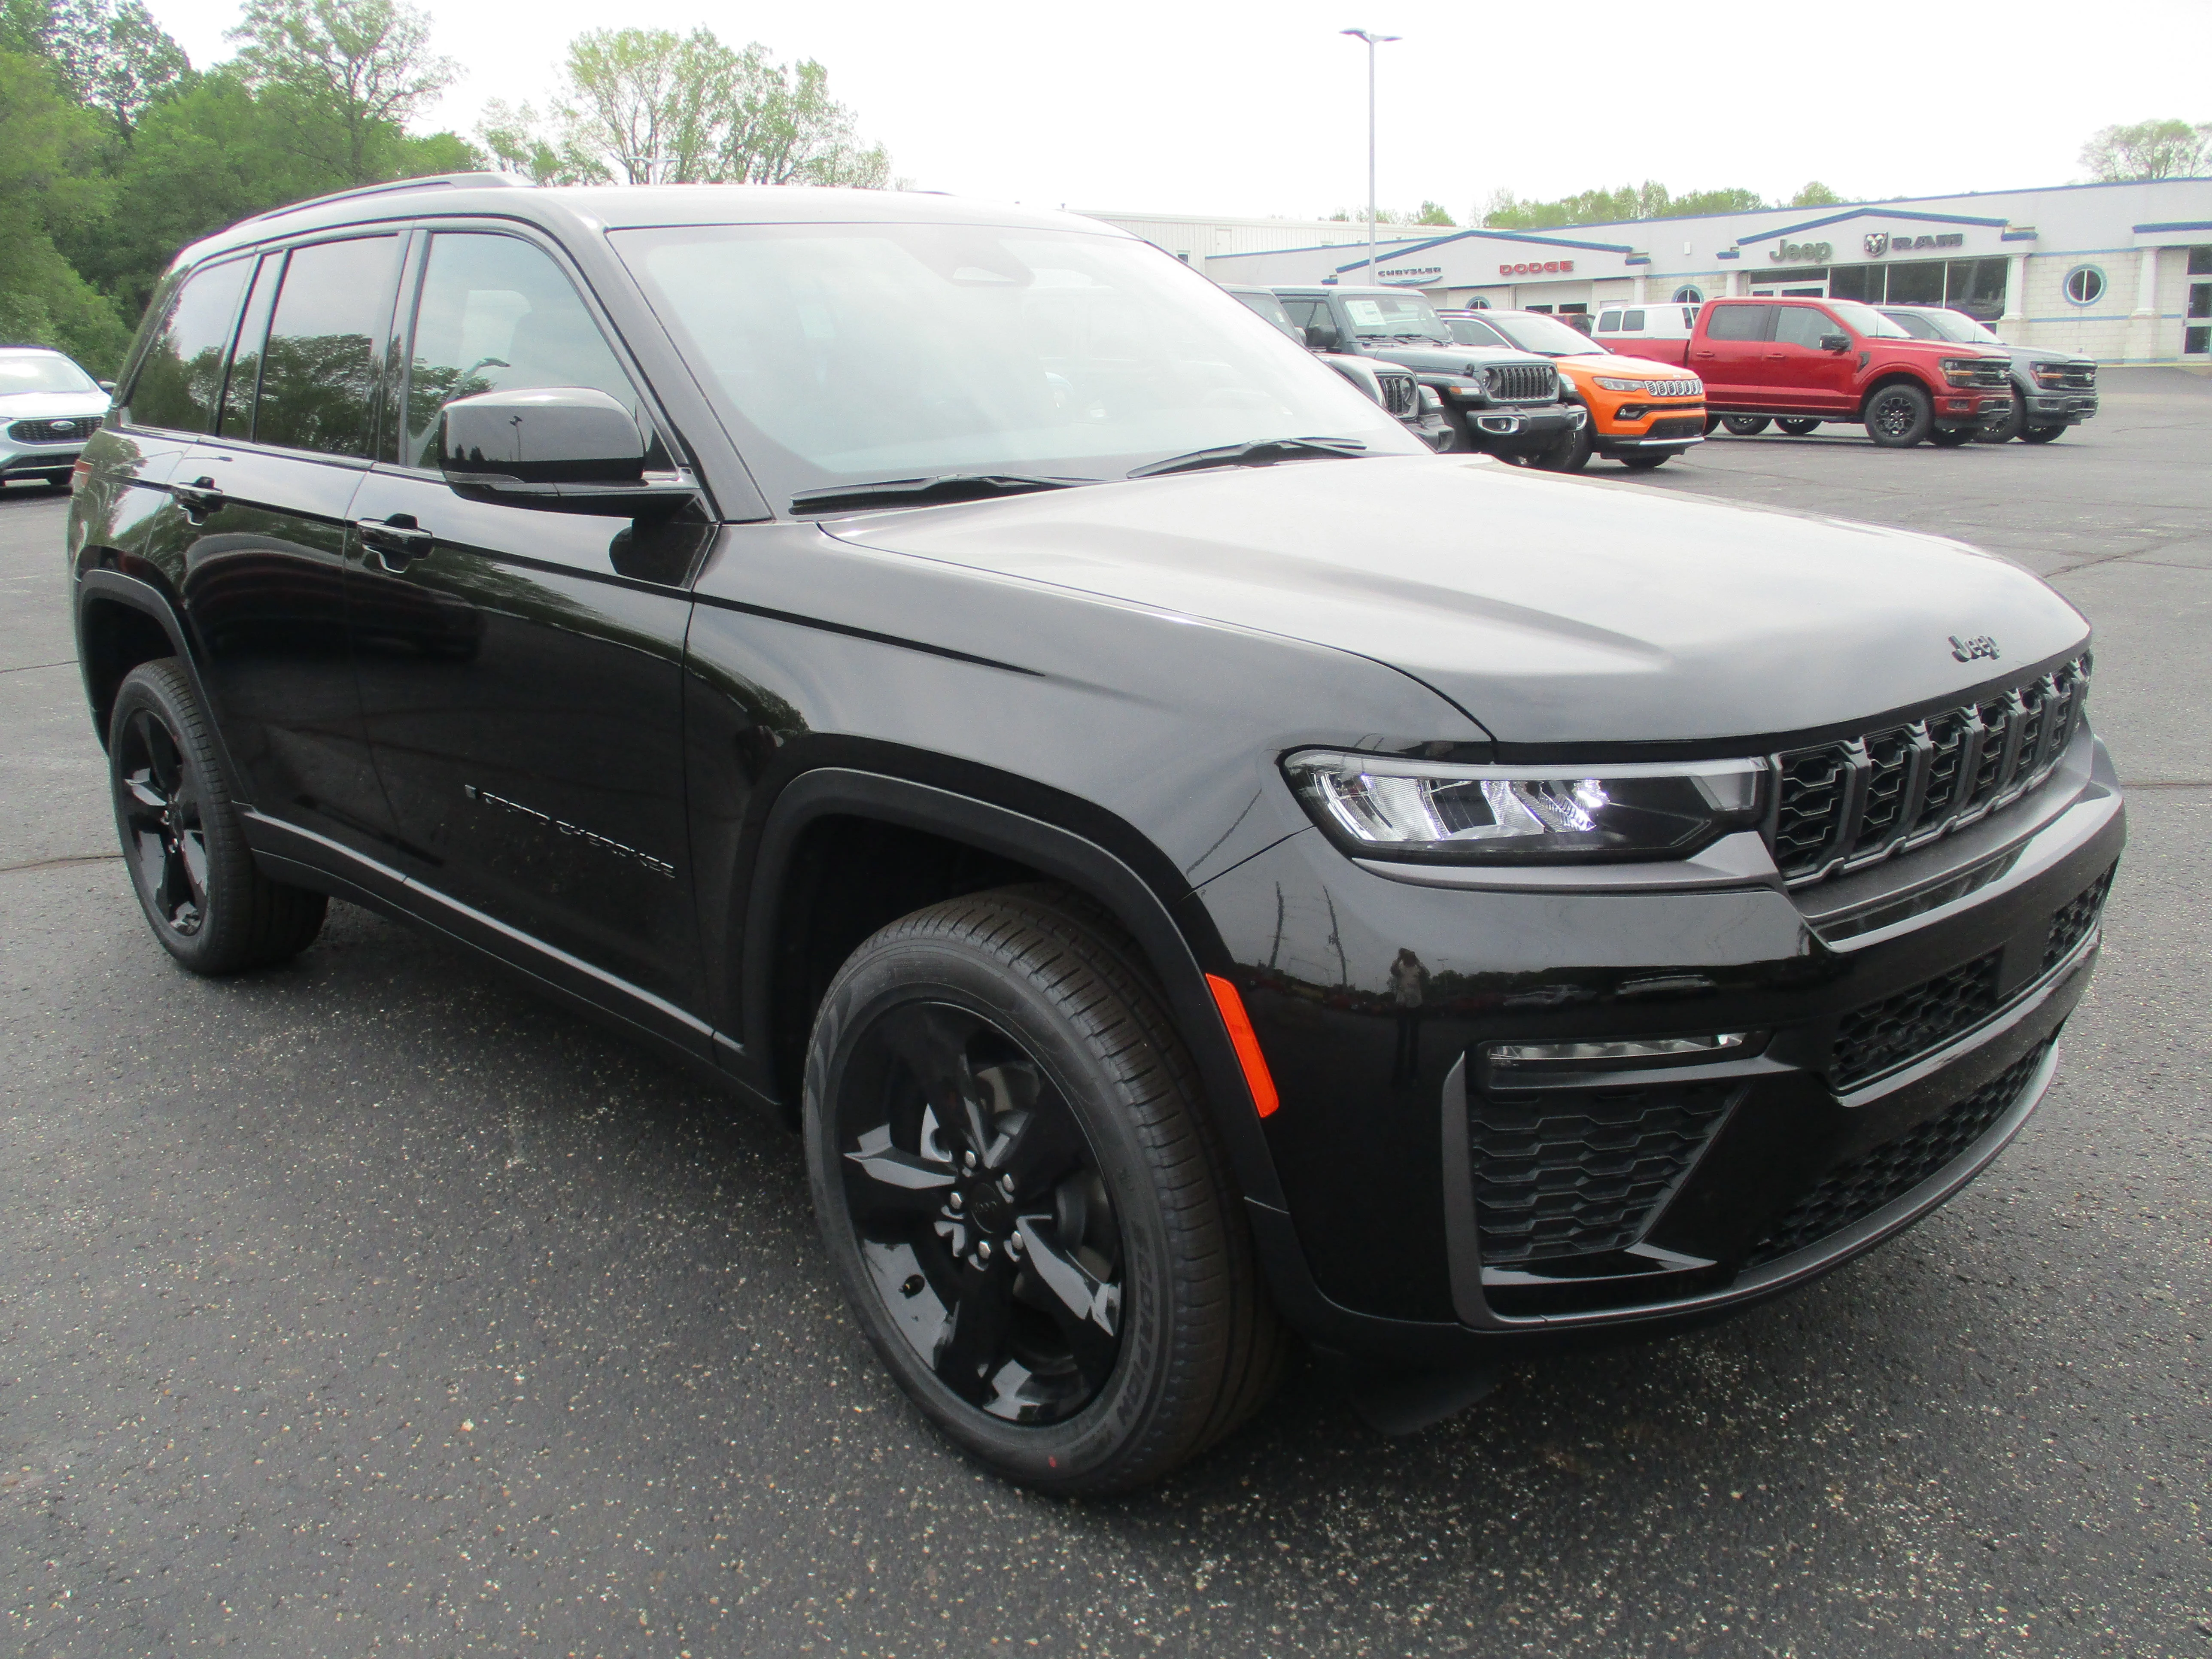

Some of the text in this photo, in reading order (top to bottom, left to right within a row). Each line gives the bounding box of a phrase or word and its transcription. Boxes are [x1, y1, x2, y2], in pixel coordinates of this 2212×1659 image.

[1892, 234, 1963, 250] RAM
[1769, 239, 1832, 264] Jeep
[1378, 267, 1441, 277] CHRYSLER
[1499, 260, 1574, 275] DODGE
[1948, 635, 2000, 662] Jeep
